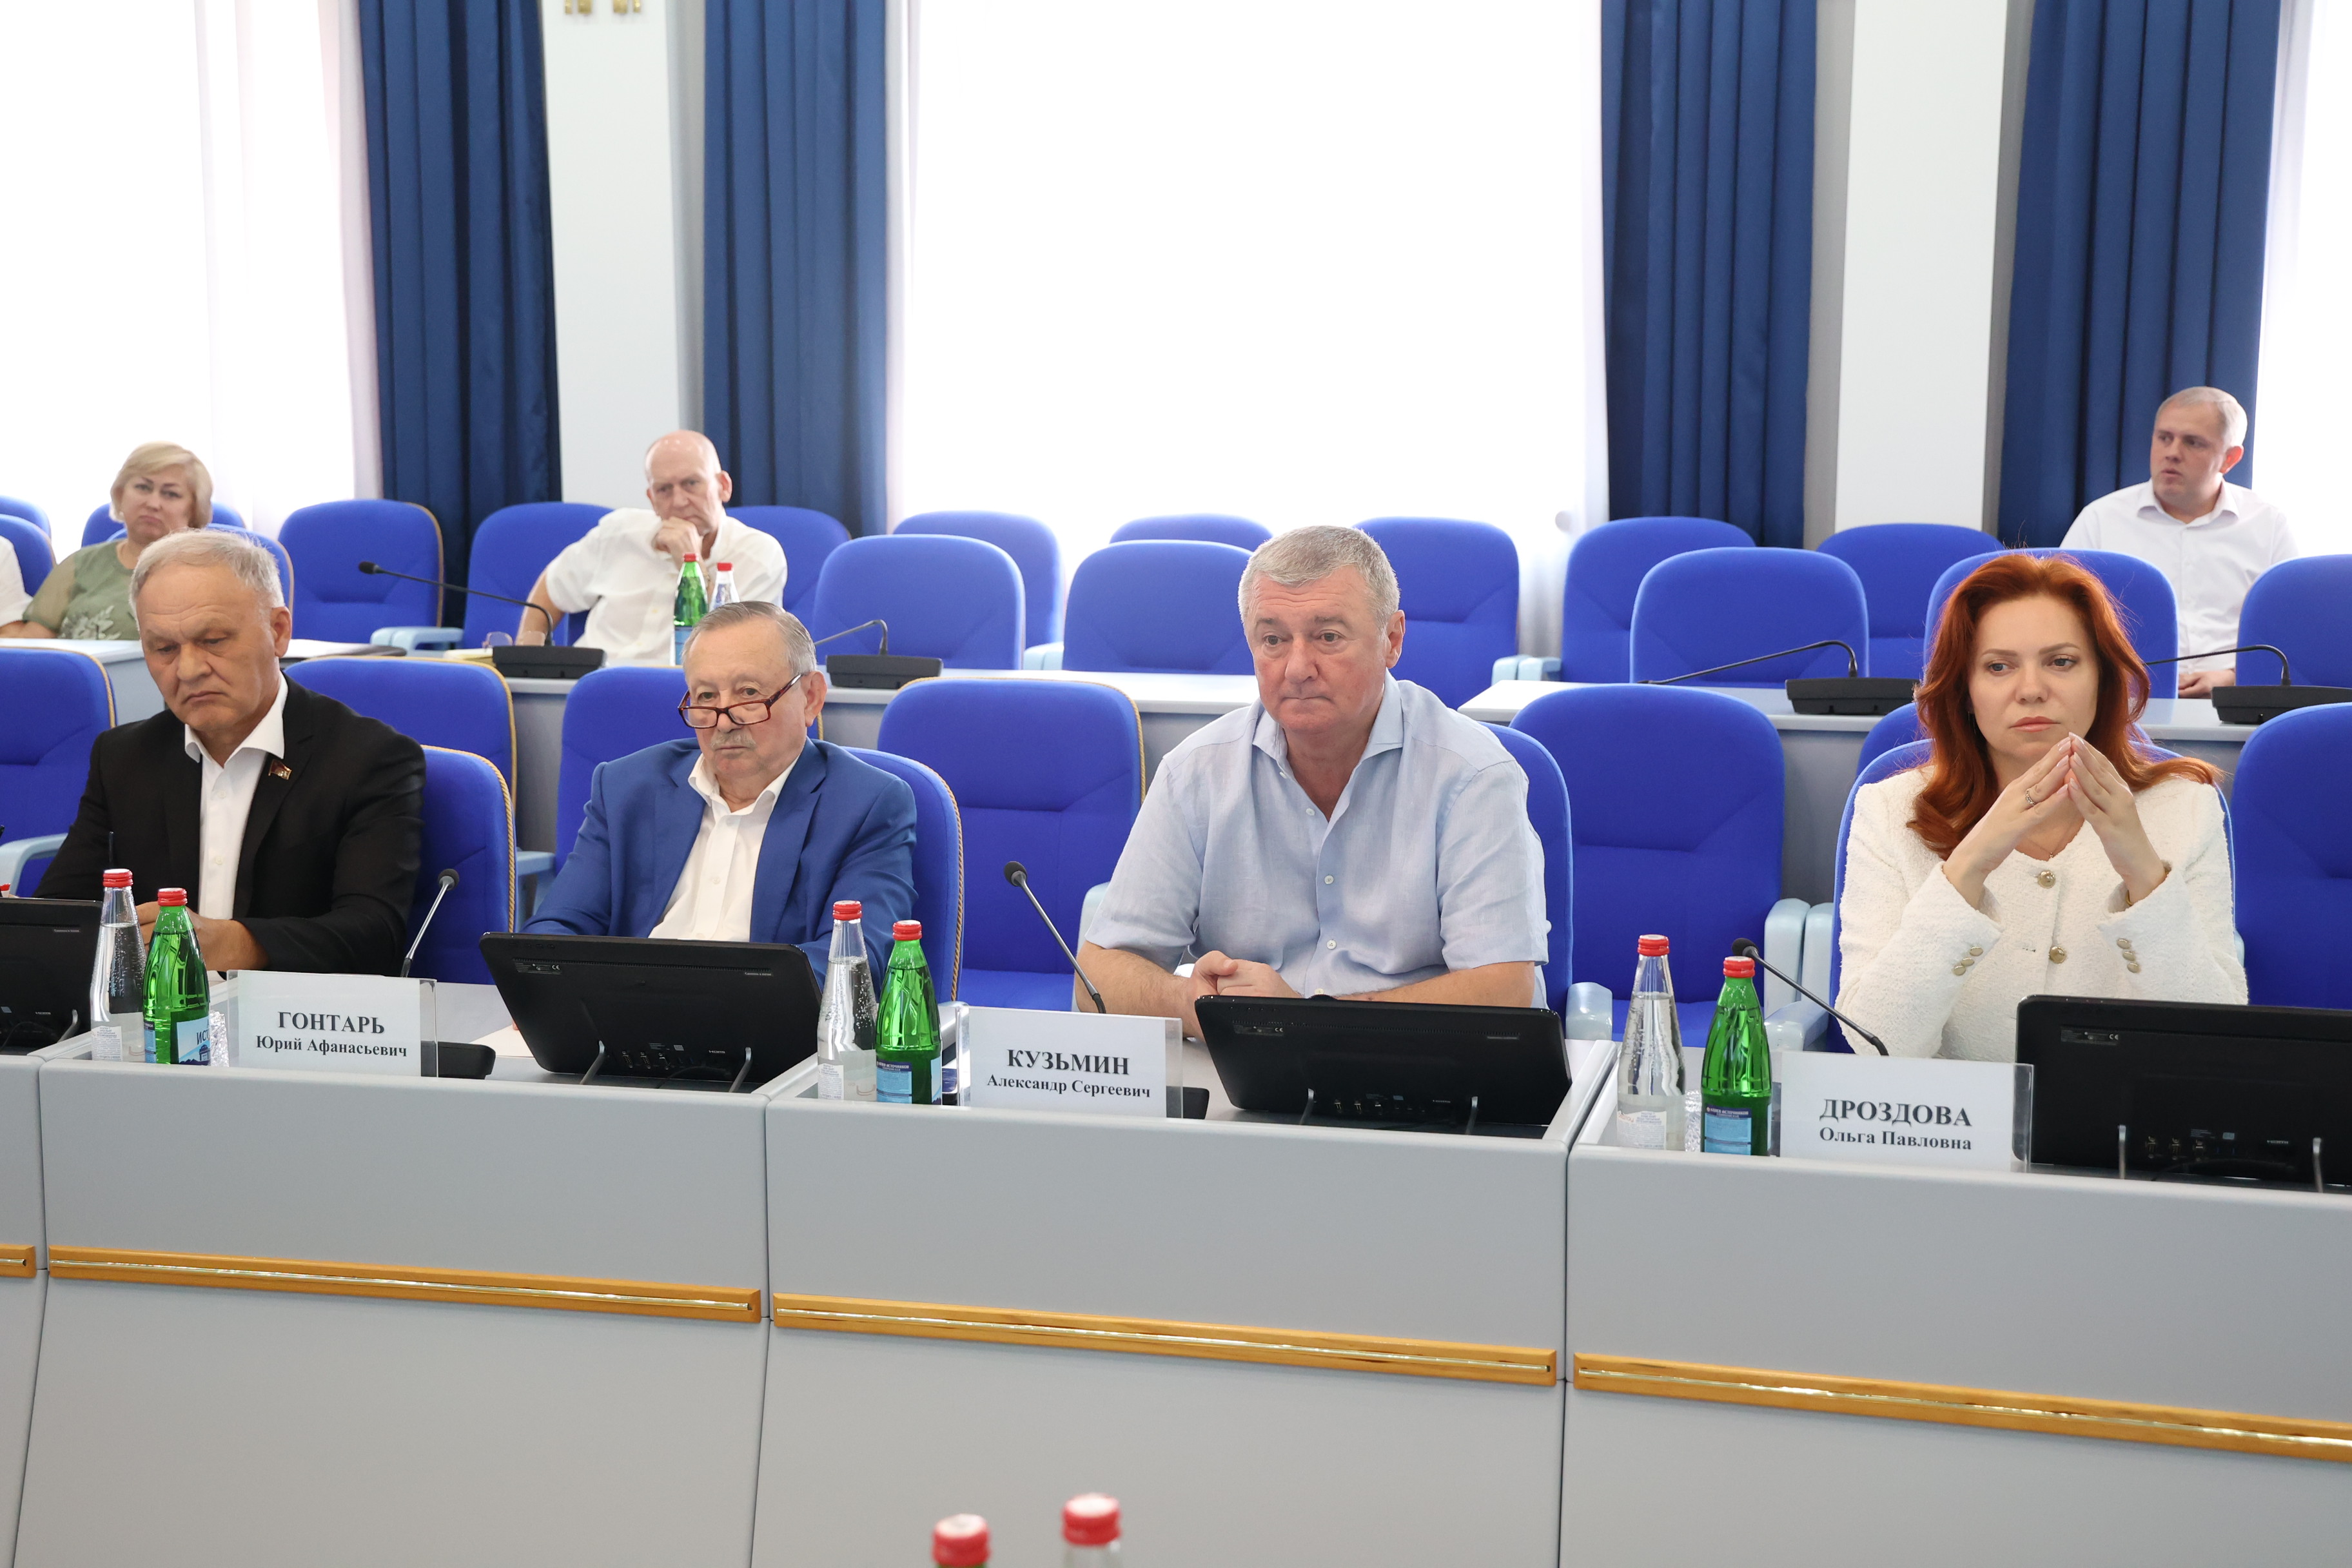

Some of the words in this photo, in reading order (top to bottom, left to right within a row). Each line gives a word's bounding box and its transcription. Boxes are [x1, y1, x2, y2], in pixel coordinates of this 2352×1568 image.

[279, 1012, 385, 1034] ГОНТАРЬ
[257, 1035, 302, 1053] Юрий
[306, 1039, 407, 1057] Афанасьевич
[1008, 1049, 1129, 1075] КУЗЬМИН
[987, 1074, 1067, 1095] Александр
[1072, 1080, 1150, 1098] Сергеевич
[1819, 1099, 1972, 1126] ДРОЗДОВА
[1819, 1127, 1876, 1144] Ольга
[1882, 1131, 1972, 1150] Павловна
